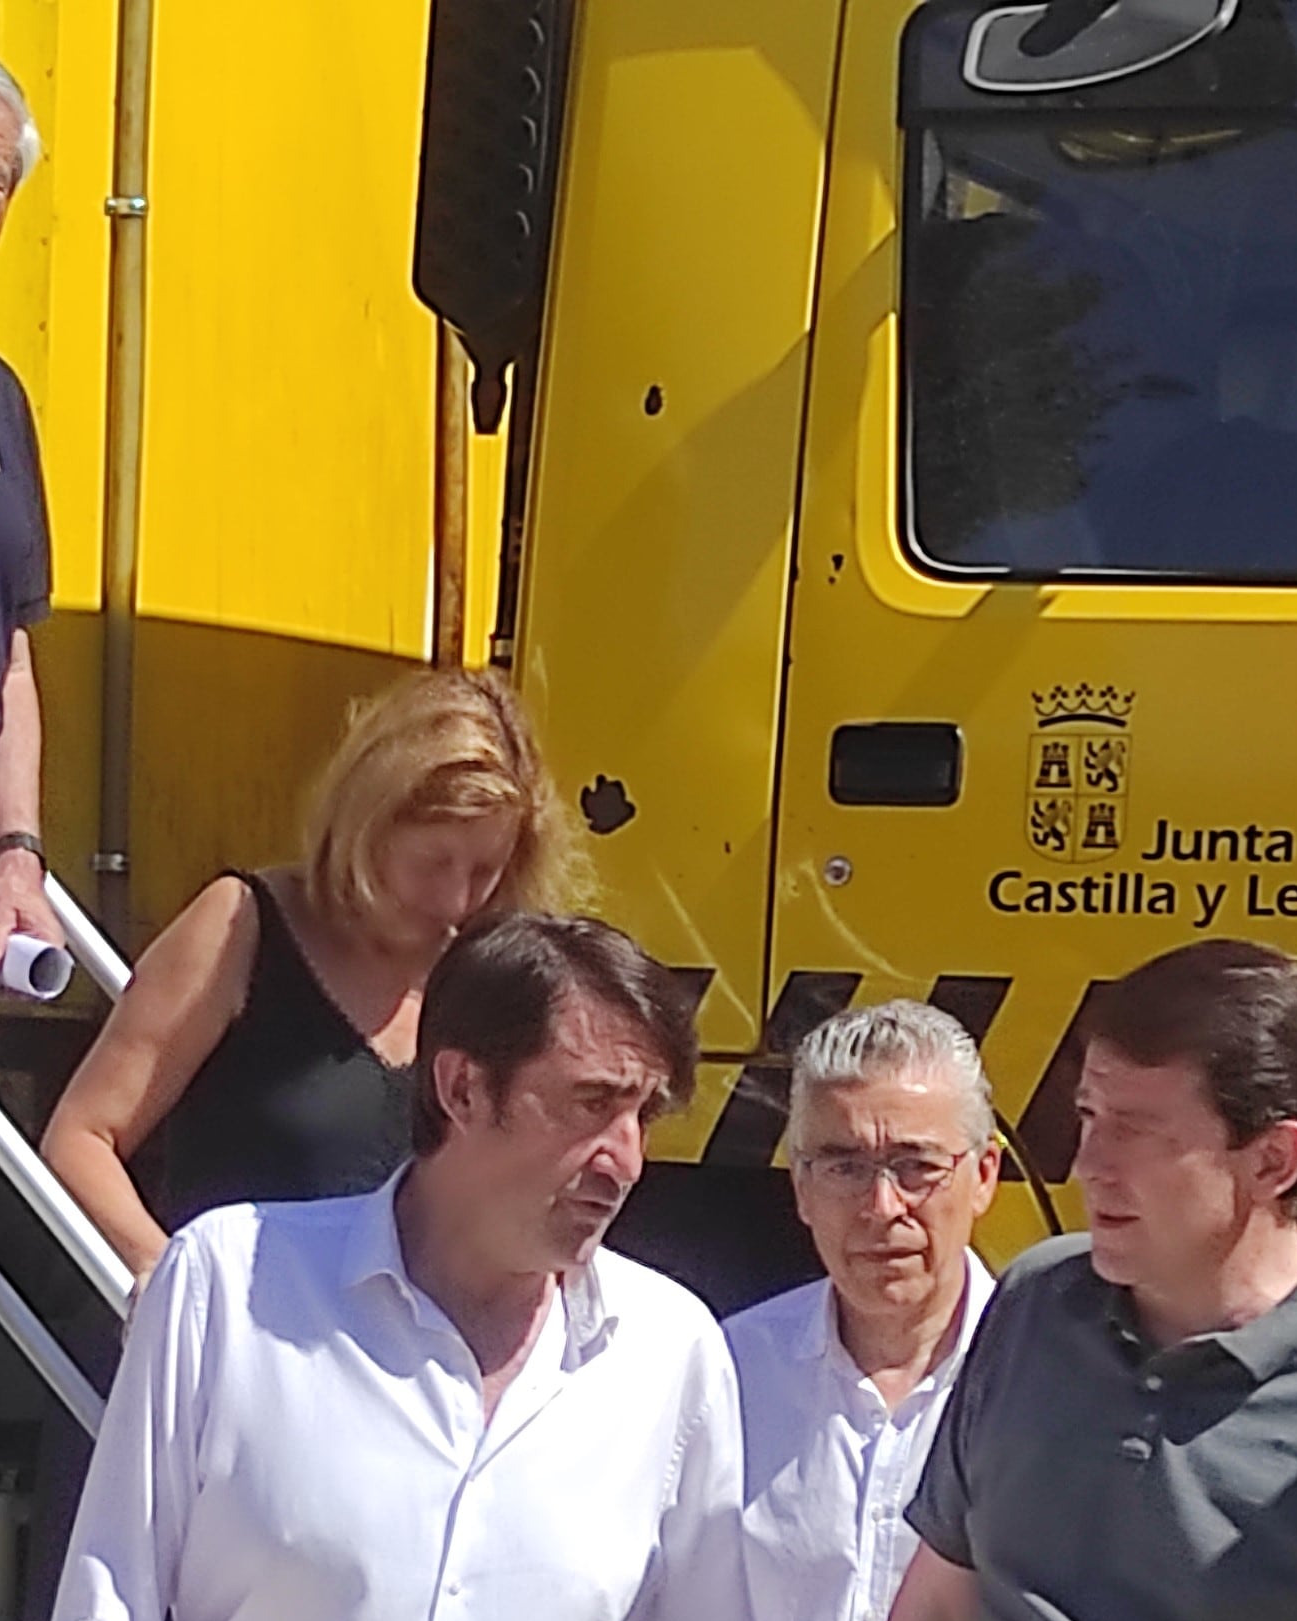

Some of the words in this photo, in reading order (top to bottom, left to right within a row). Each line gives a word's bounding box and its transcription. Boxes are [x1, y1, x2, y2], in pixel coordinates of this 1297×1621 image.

[1141, 819, 1295, 863] Junta
[988, 870, 1177, 915] Castilla
[1193, 883, 1227, 929] y
